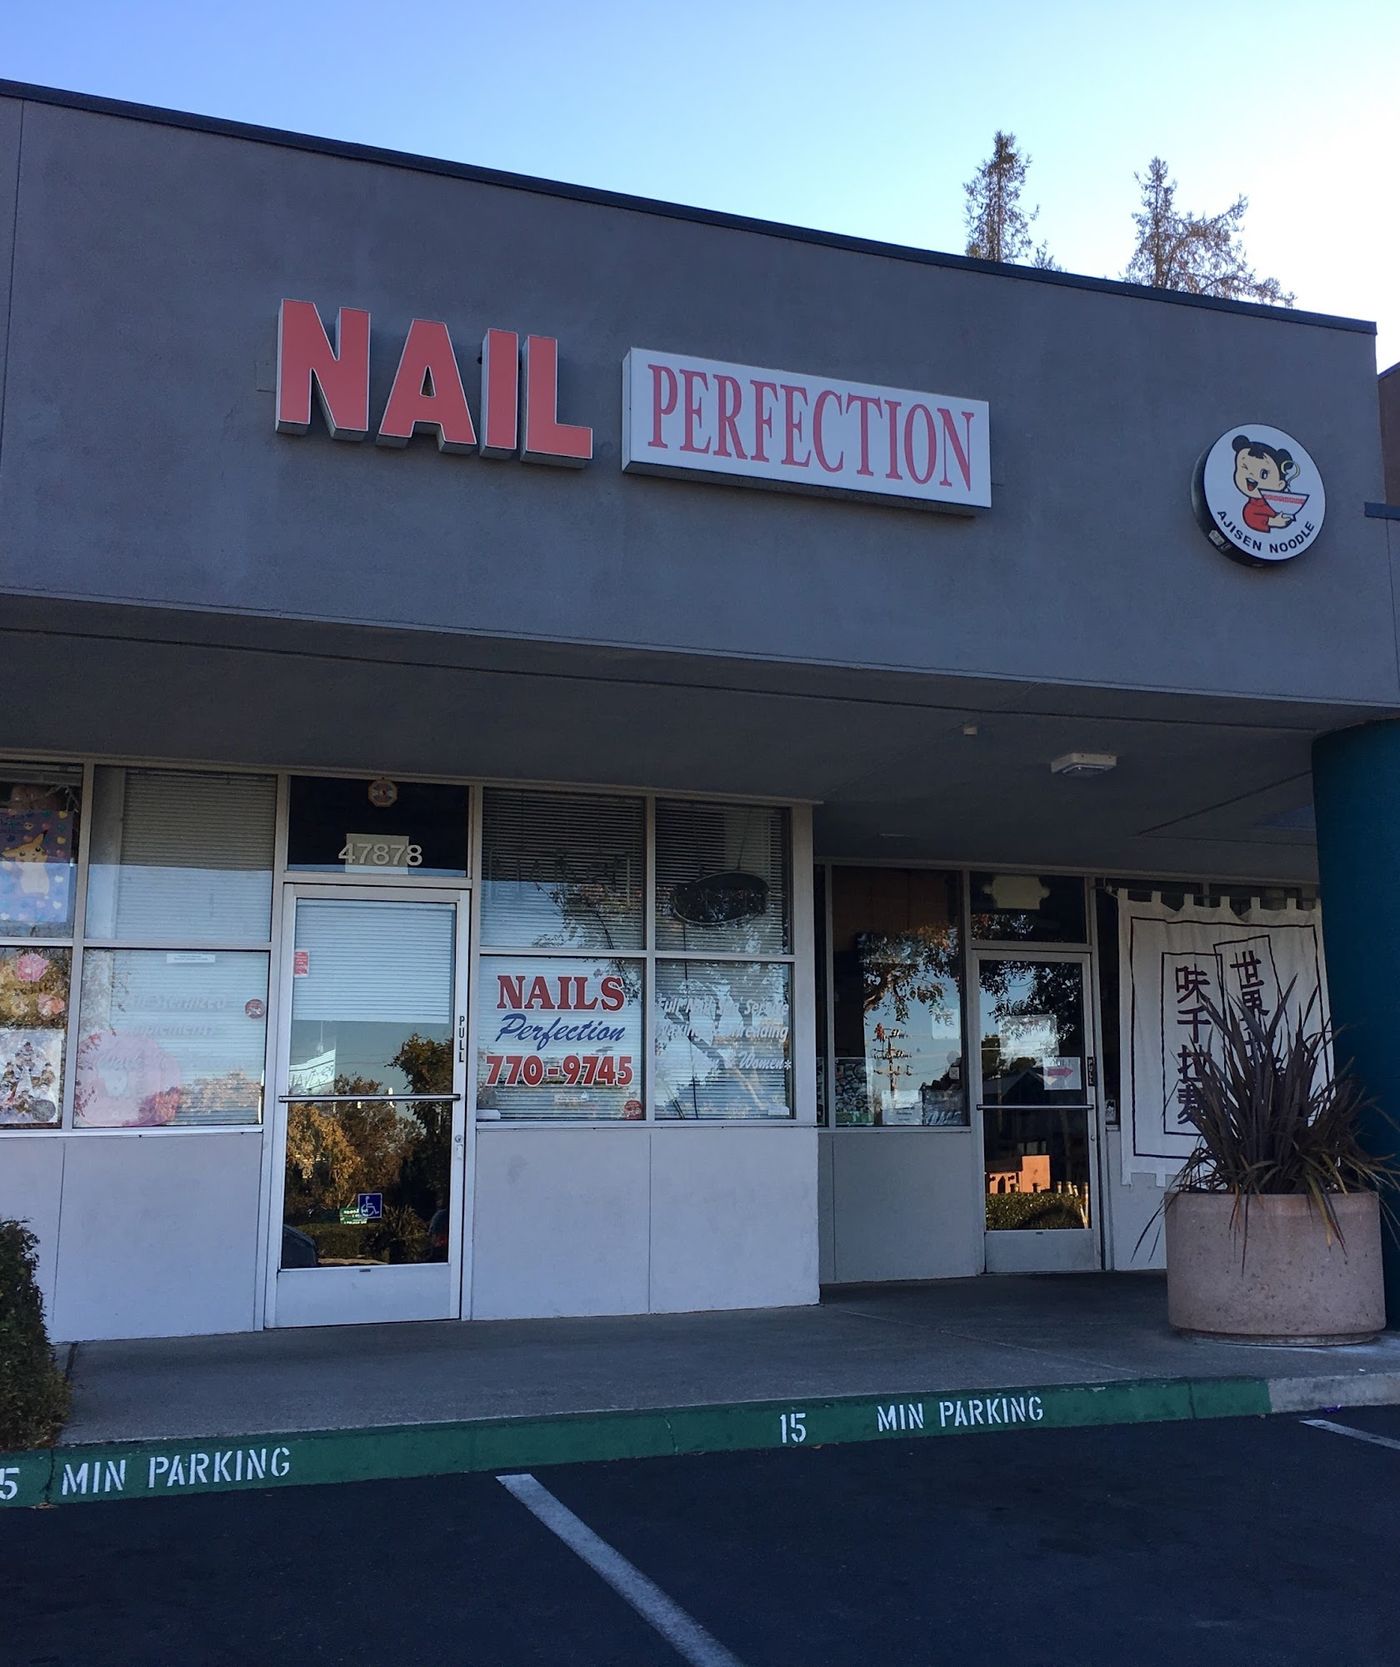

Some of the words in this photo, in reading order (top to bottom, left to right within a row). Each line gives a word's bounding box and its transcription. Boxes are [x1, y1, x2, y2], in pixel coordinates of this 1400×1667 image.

[278, 299, 594, 464] NAIL
[647, 363, 975, 493] PERFECTION
[1217, 510, 1262, 551] AJISEN
[1269, 520, 1315, 554] NOODLE
[338, 842, 423, 866] 47878
[496, 974, 626, 1012] NAILS
[495, 1013, 626, 1051] Perfection
[485, 1055, 634, 1087] 770-9745
[779, 1412, 807, 1443] 15
[877, 1403, 924, 1432] MIN
[939, 1396, 1044, 1427] PARKING
[61, 1459, 126, 1495] MIN
[148, 1447, 290, 1489] PARKING
